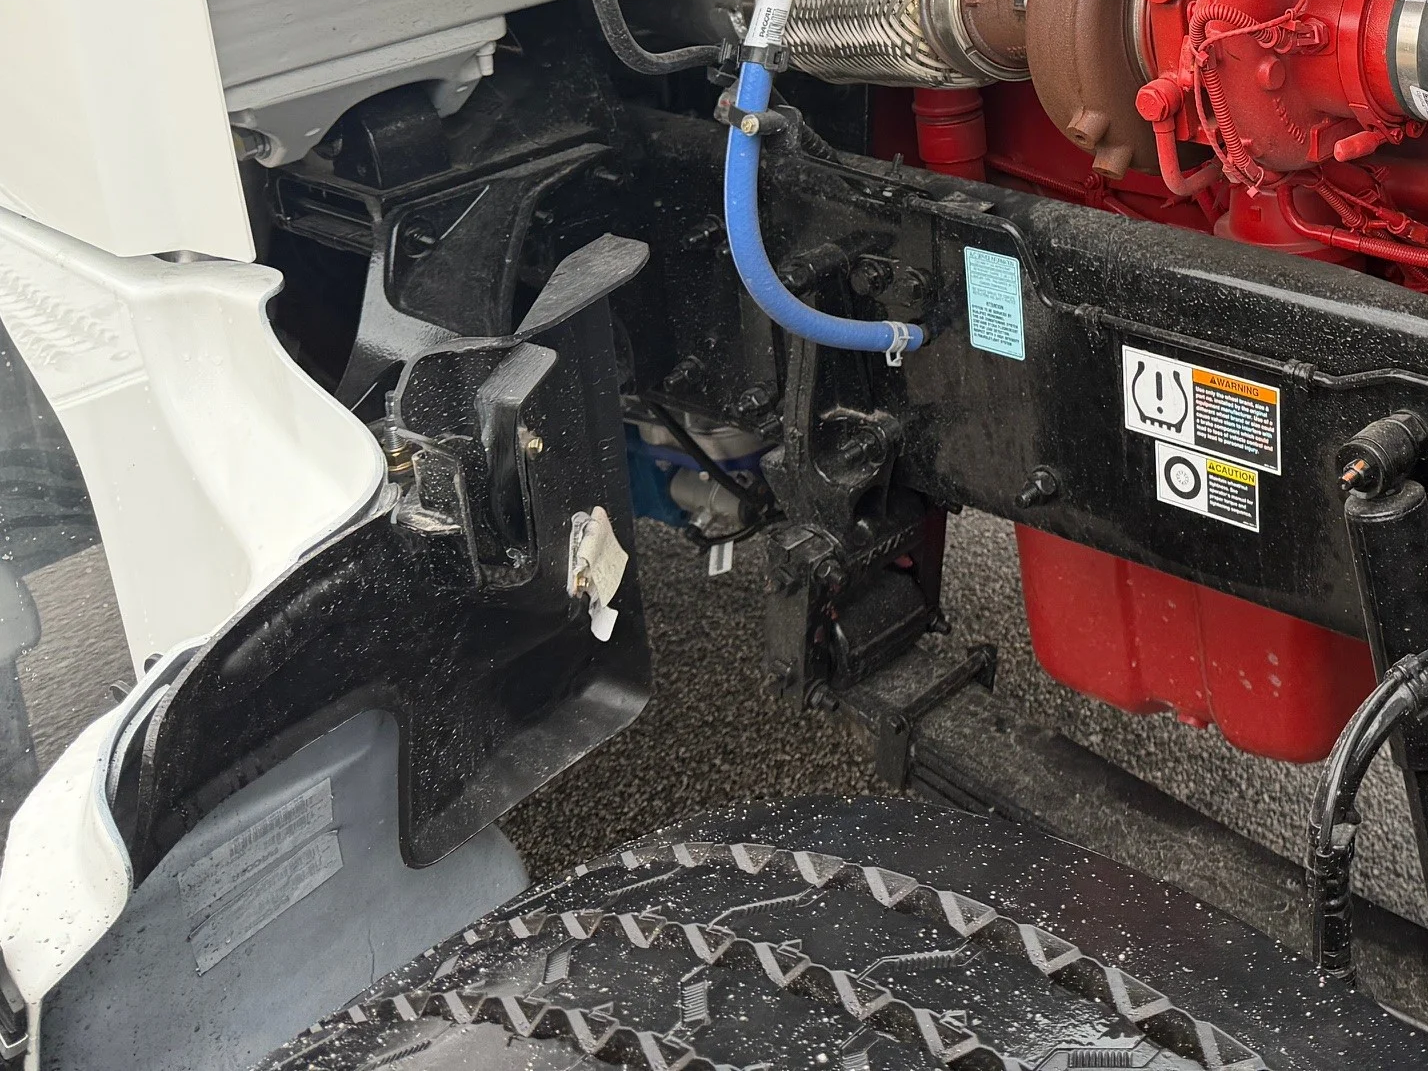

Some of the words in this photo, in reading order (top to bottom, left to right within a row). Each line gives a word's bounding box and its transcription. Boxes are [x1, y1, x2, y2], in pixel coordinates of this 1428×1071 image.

[758, 6, 772, 37] PACCAR
[1216, 378, 1258, 396] WARNING
[1215, 463, 1254, 483] CAUTION
